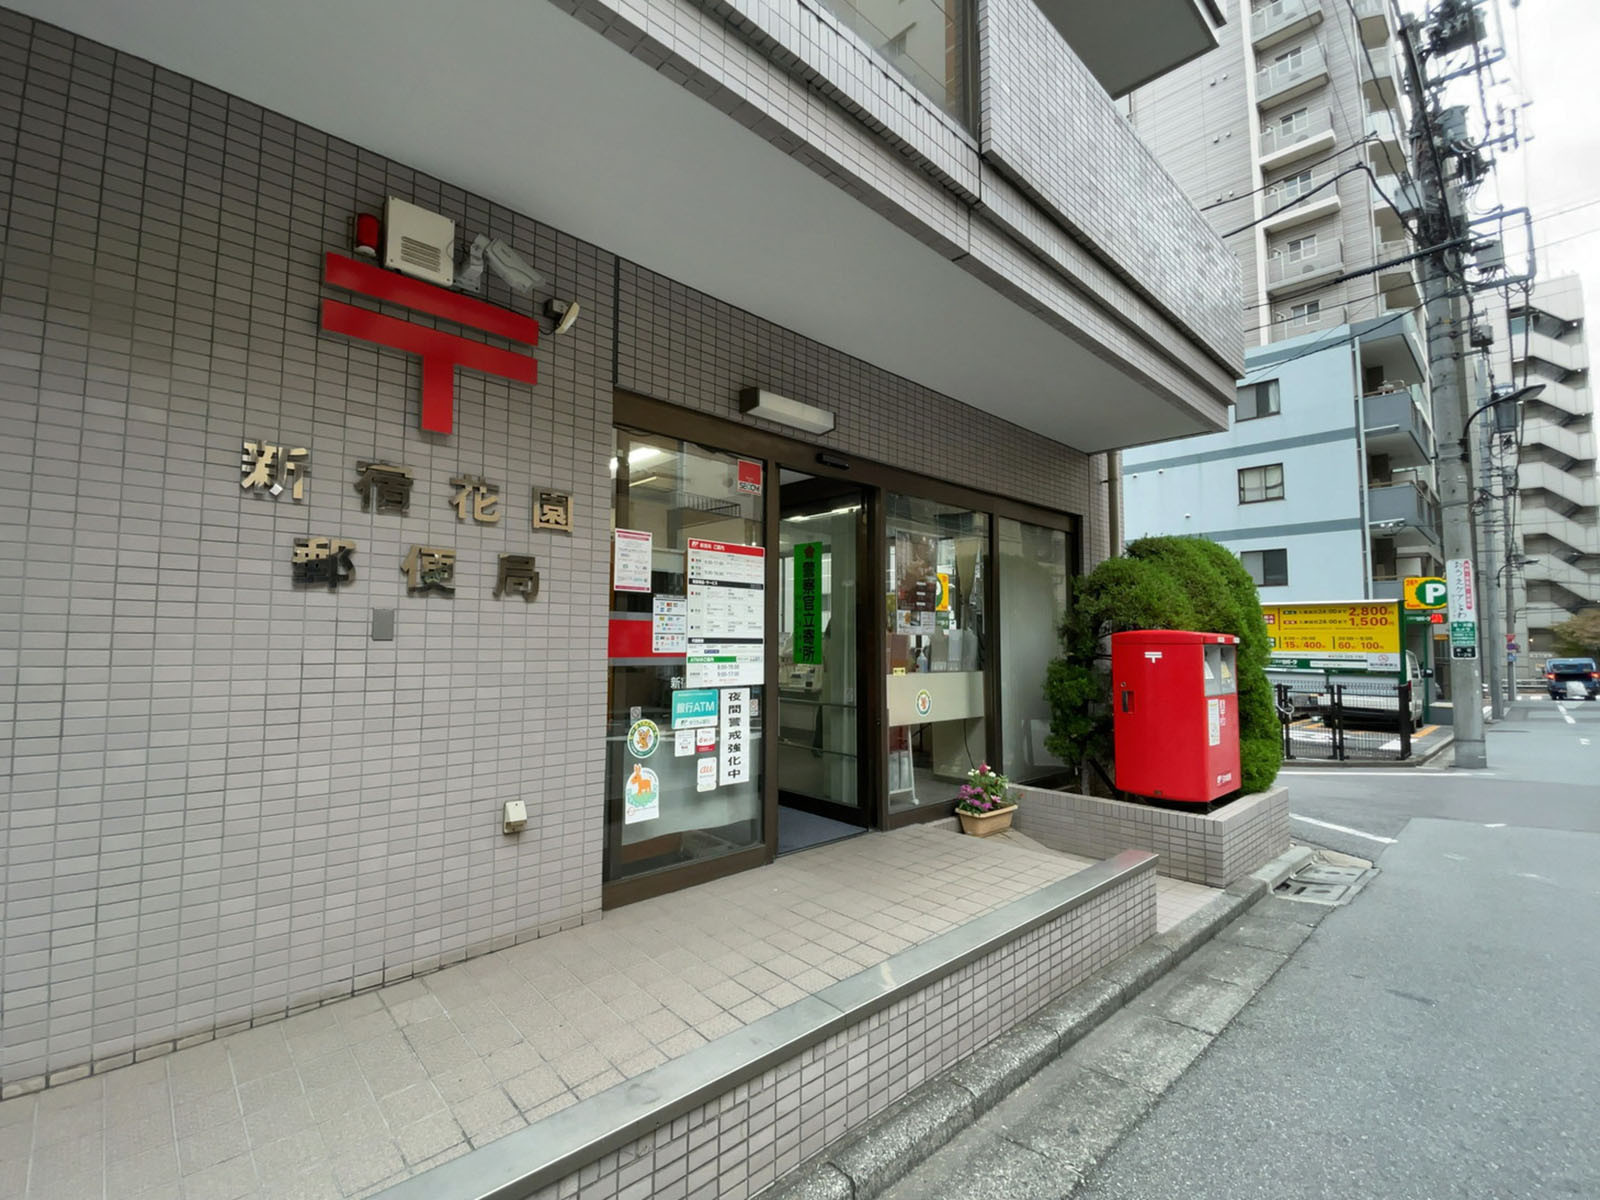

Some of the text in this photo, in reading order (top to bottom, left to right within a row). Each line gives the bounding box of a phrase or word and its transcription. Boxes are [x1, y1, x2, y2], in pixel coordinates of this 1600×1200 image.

[291, 536, 541, 602] 郵便局
[802, 561, 816, 663] 警察官立寄所
[1425, 583, 1446, 604] P
[676, 700, 715, 714] 銀行ATM
[727, 691, 742, 779] 夜間警戒強化中
[699, 765, 713, 774] au
